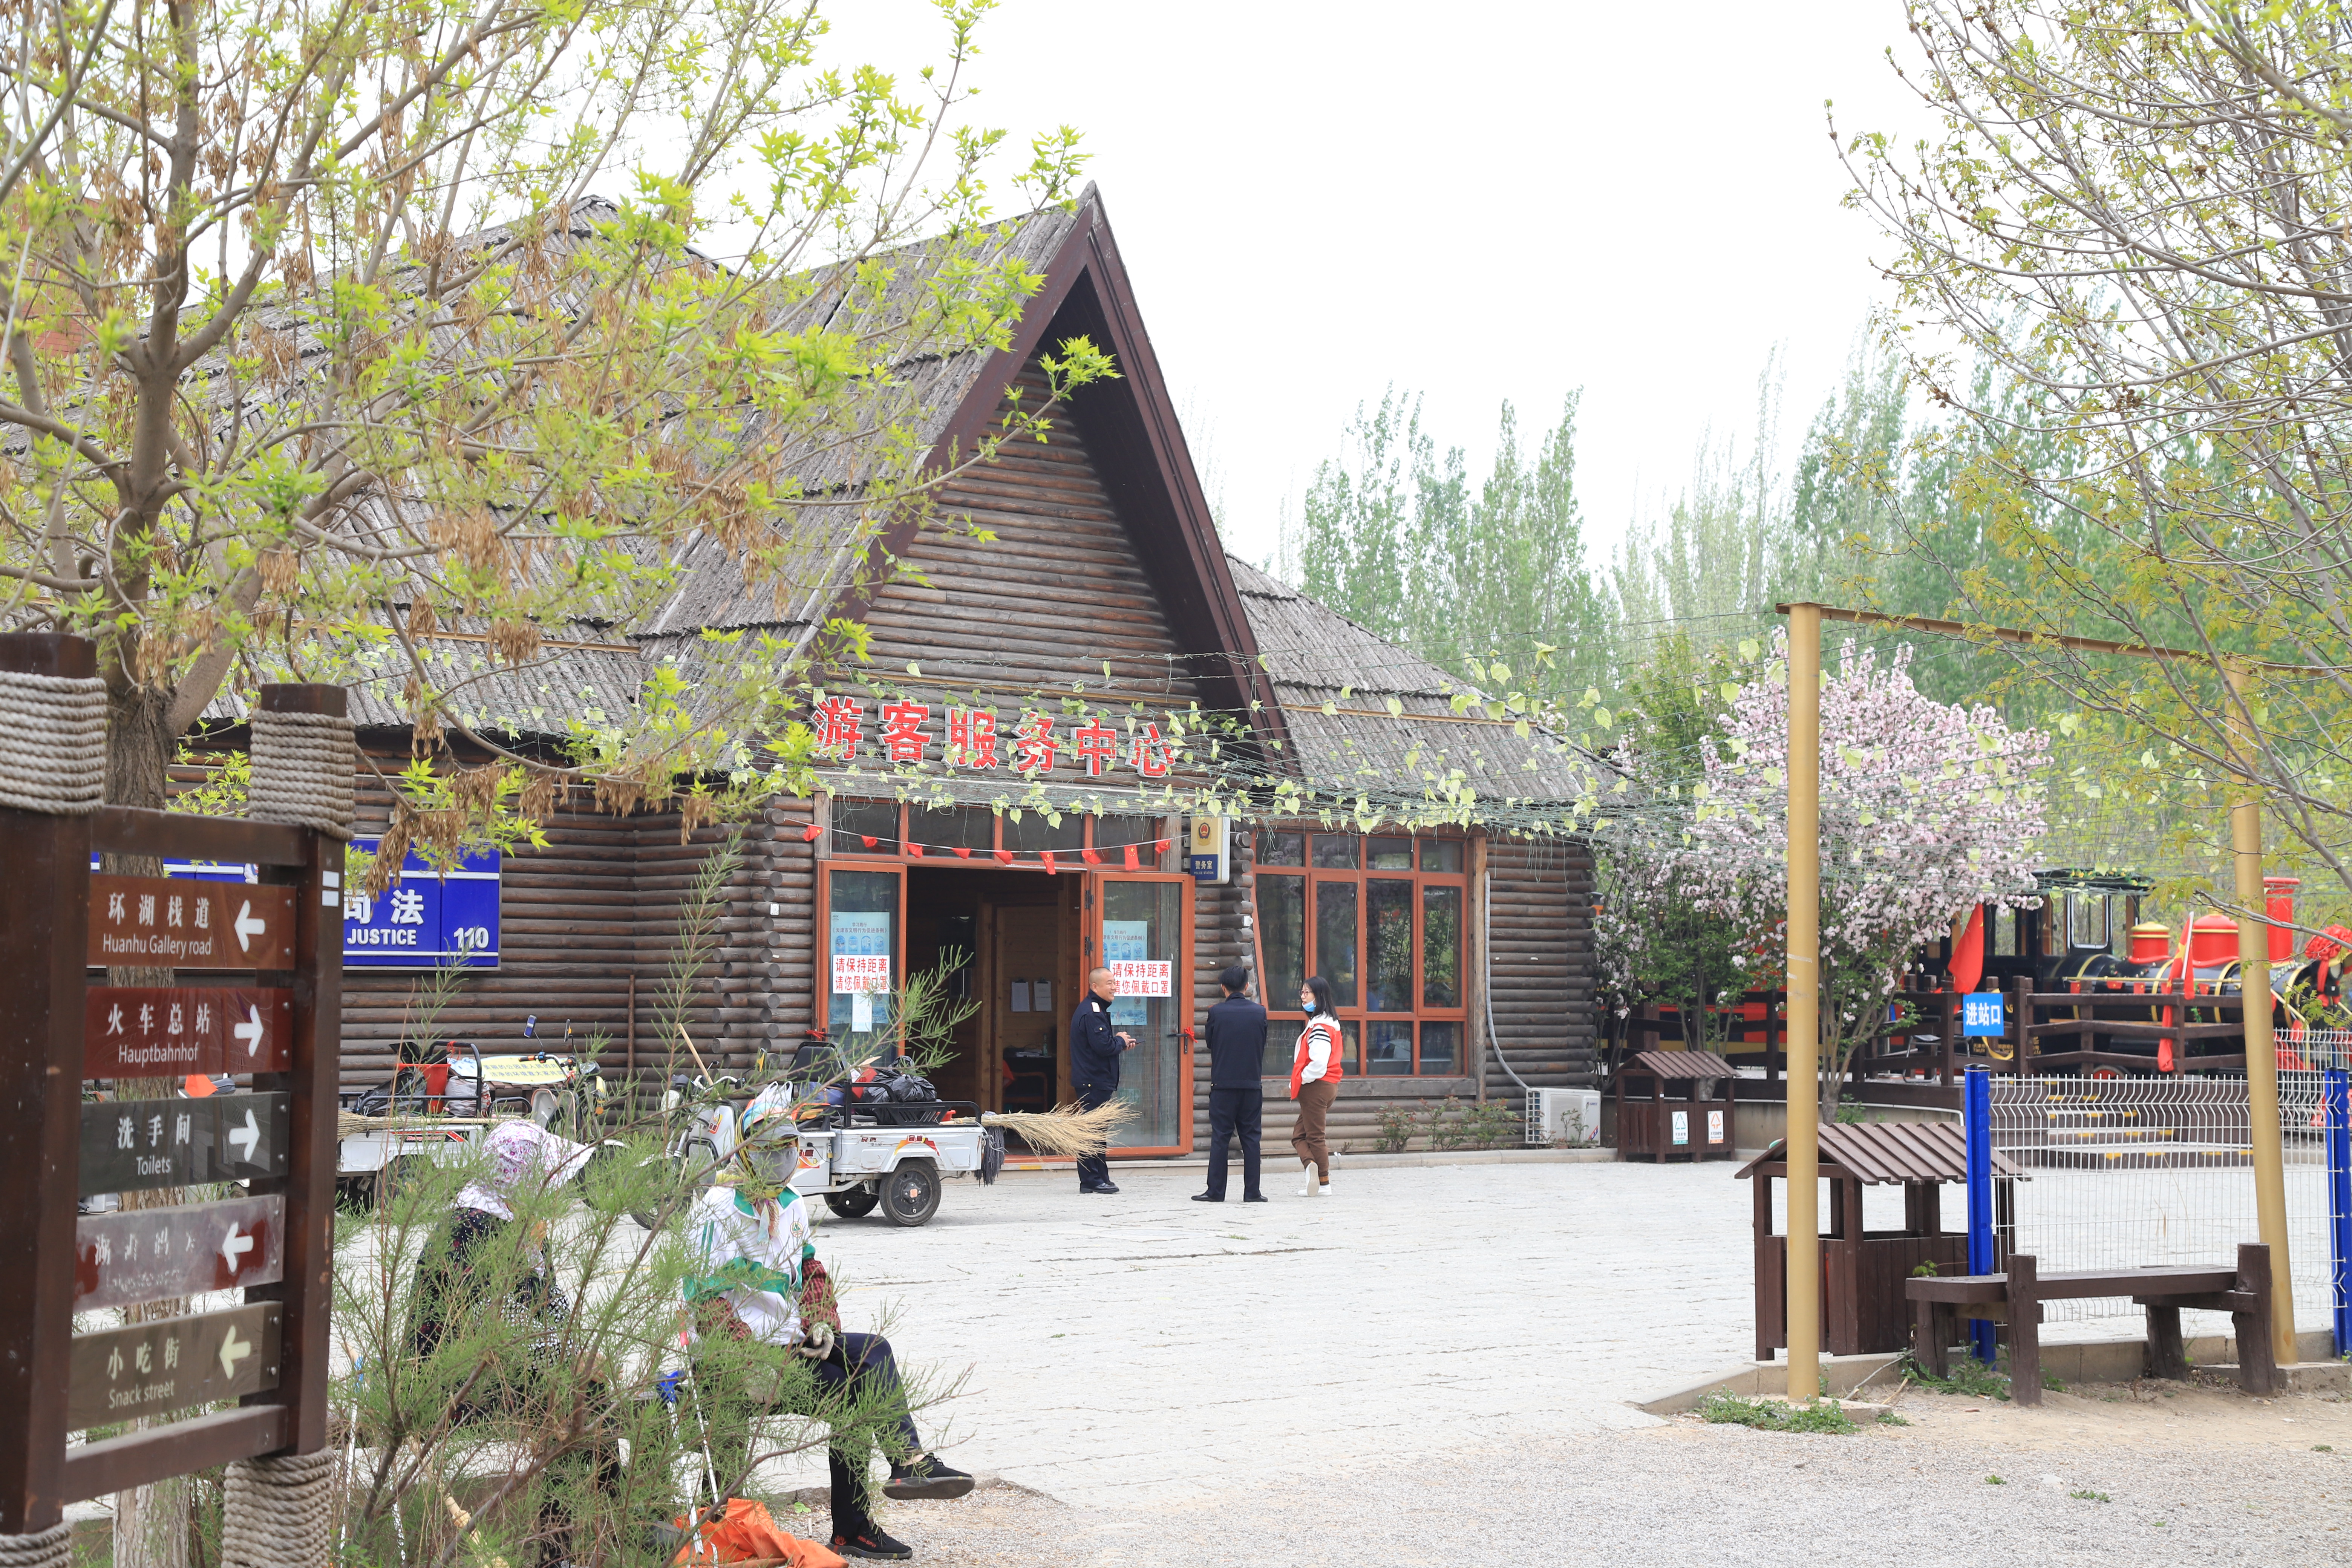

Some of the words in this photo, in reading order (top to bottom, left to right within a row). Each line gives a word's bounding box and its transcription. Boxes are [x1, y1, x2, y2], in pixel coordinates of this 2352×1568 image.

[810, 695, 1176, 778] 游客服务中心
[1195, 860, 1213, 870] 警务室
[108, 892, 210, 929] 环湖栈道
[343, 888, 424, 925] 司法
[103, 933, 146, 954] Huanhu
[149, 934, 187, 960] Gallery
[189, 937, 211, 955] road
[347, 928, 417, 946] JUSTICE
[453, 926, 490, 950] 110
[835, 957, 887, 973] 请保持距离
[1112, 963, 1169, 978] 请保持距离
[835, 975, 887, 991] 请您佩戴口罩
[106, 1002, 210, 1036] 火车总站
[1966, 1002, 2001, 1026] 进站口
[118, 1042, 199, 1068] Hauptbahnhof
[117, 1113, 191, 1150] 洗手间
[136, 1155, 171, 1176] Toilets
[107, 1337, 180, 1380] 小吃街
[109, 1386, 142, 1409] Snack
[144, 1380, 175, 1401] street
